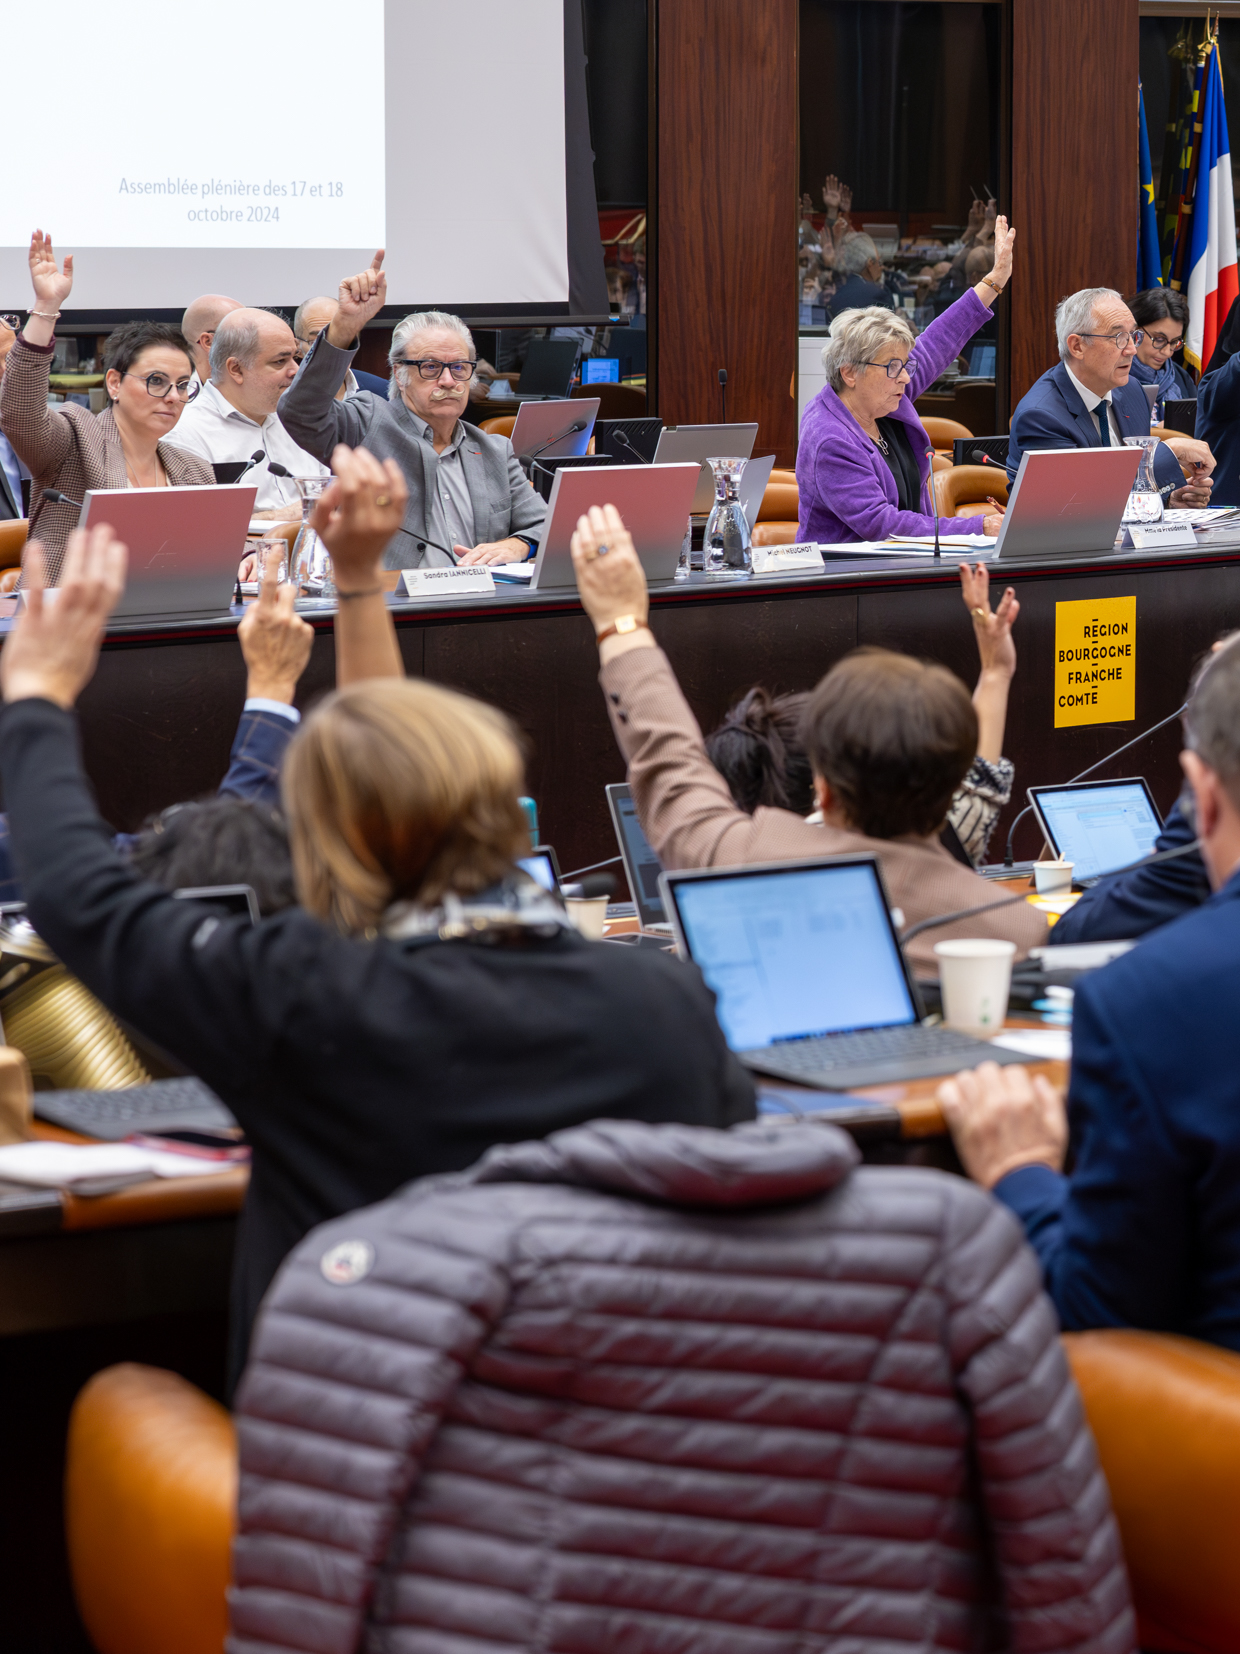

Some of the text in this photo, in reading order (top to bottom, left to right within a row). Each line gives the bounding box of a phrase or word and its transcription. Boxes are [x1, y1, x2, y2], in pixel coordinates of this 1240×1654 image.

[118, 177, 344, 199] Assemblée plénière des 17 et 18
[187, 204, 280, 222] octobre 2024
[423, 567, 487, 580] Sandra IANNICELLI
[1058, 643, 1132, 663] BOURGOGNE
[1067, 667, 1123, 685] FRANCHE
